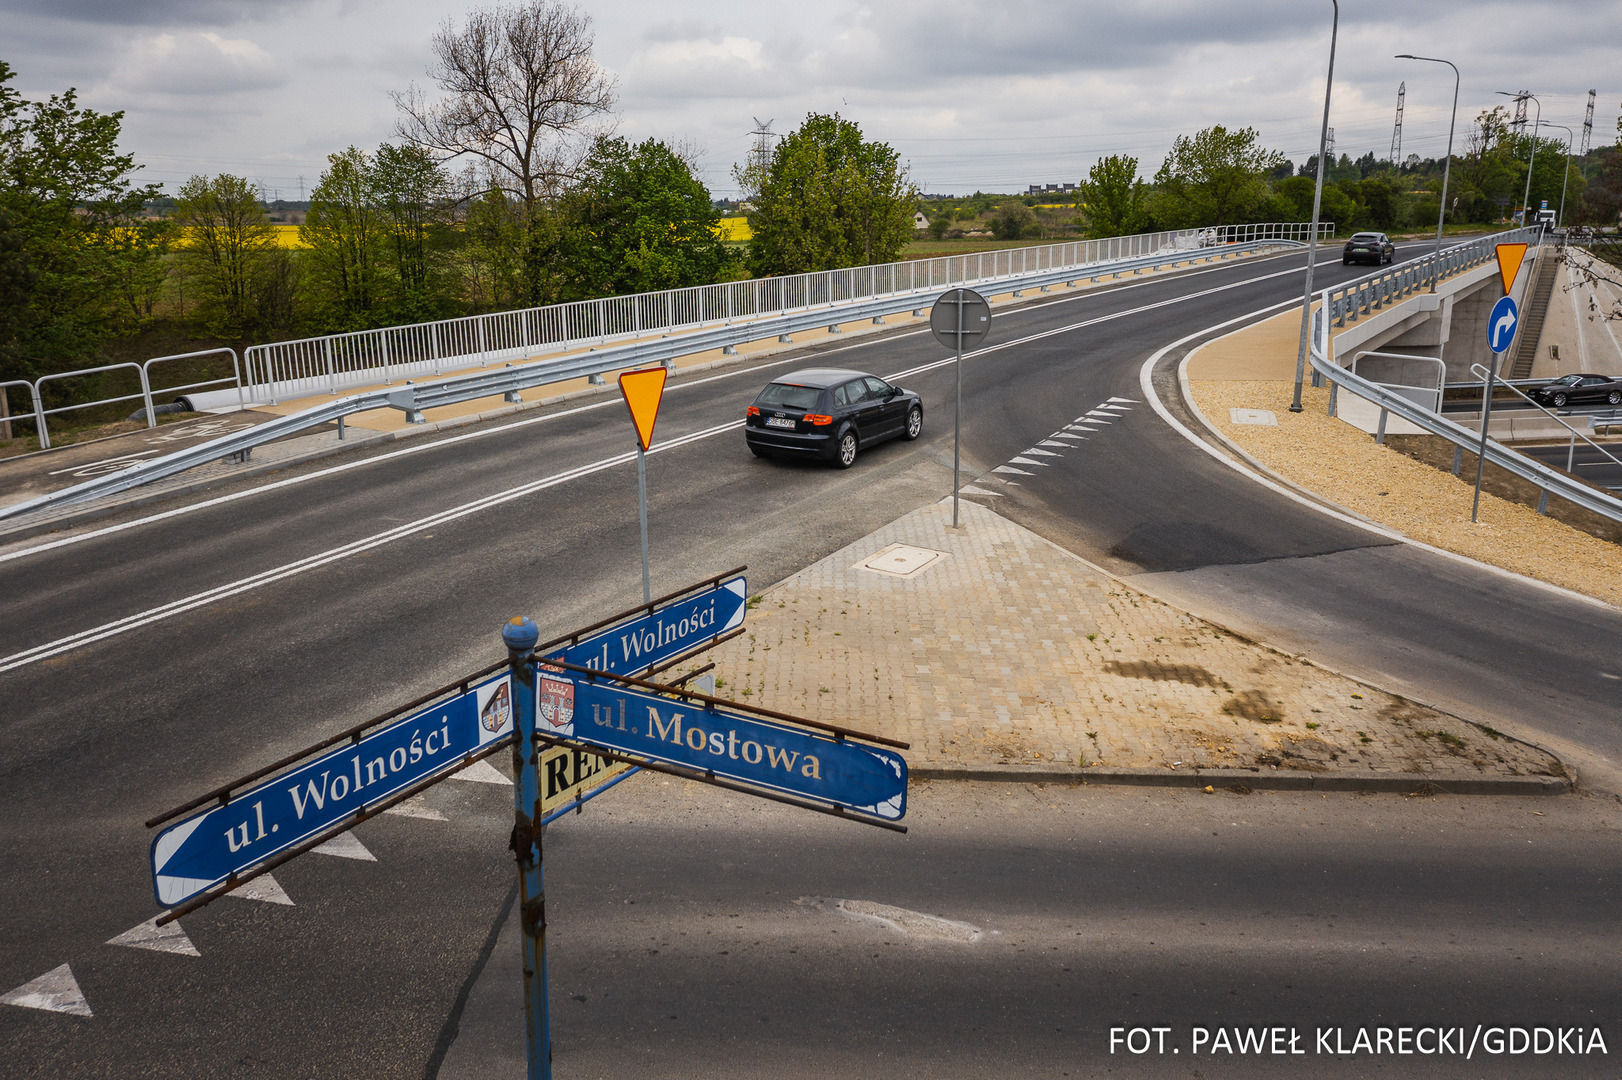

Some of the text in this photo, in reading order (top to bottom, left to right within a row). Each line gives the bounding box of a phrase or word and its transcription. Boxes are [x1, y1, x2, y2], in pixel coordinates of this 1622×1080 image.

[585, 598, 716, 673] ul. Wolności
[545, 750, 622, 800] REN
[592, 699, 823, 781] ul. Mostowa
[224, 715, 452, 853] ul. Wolności
